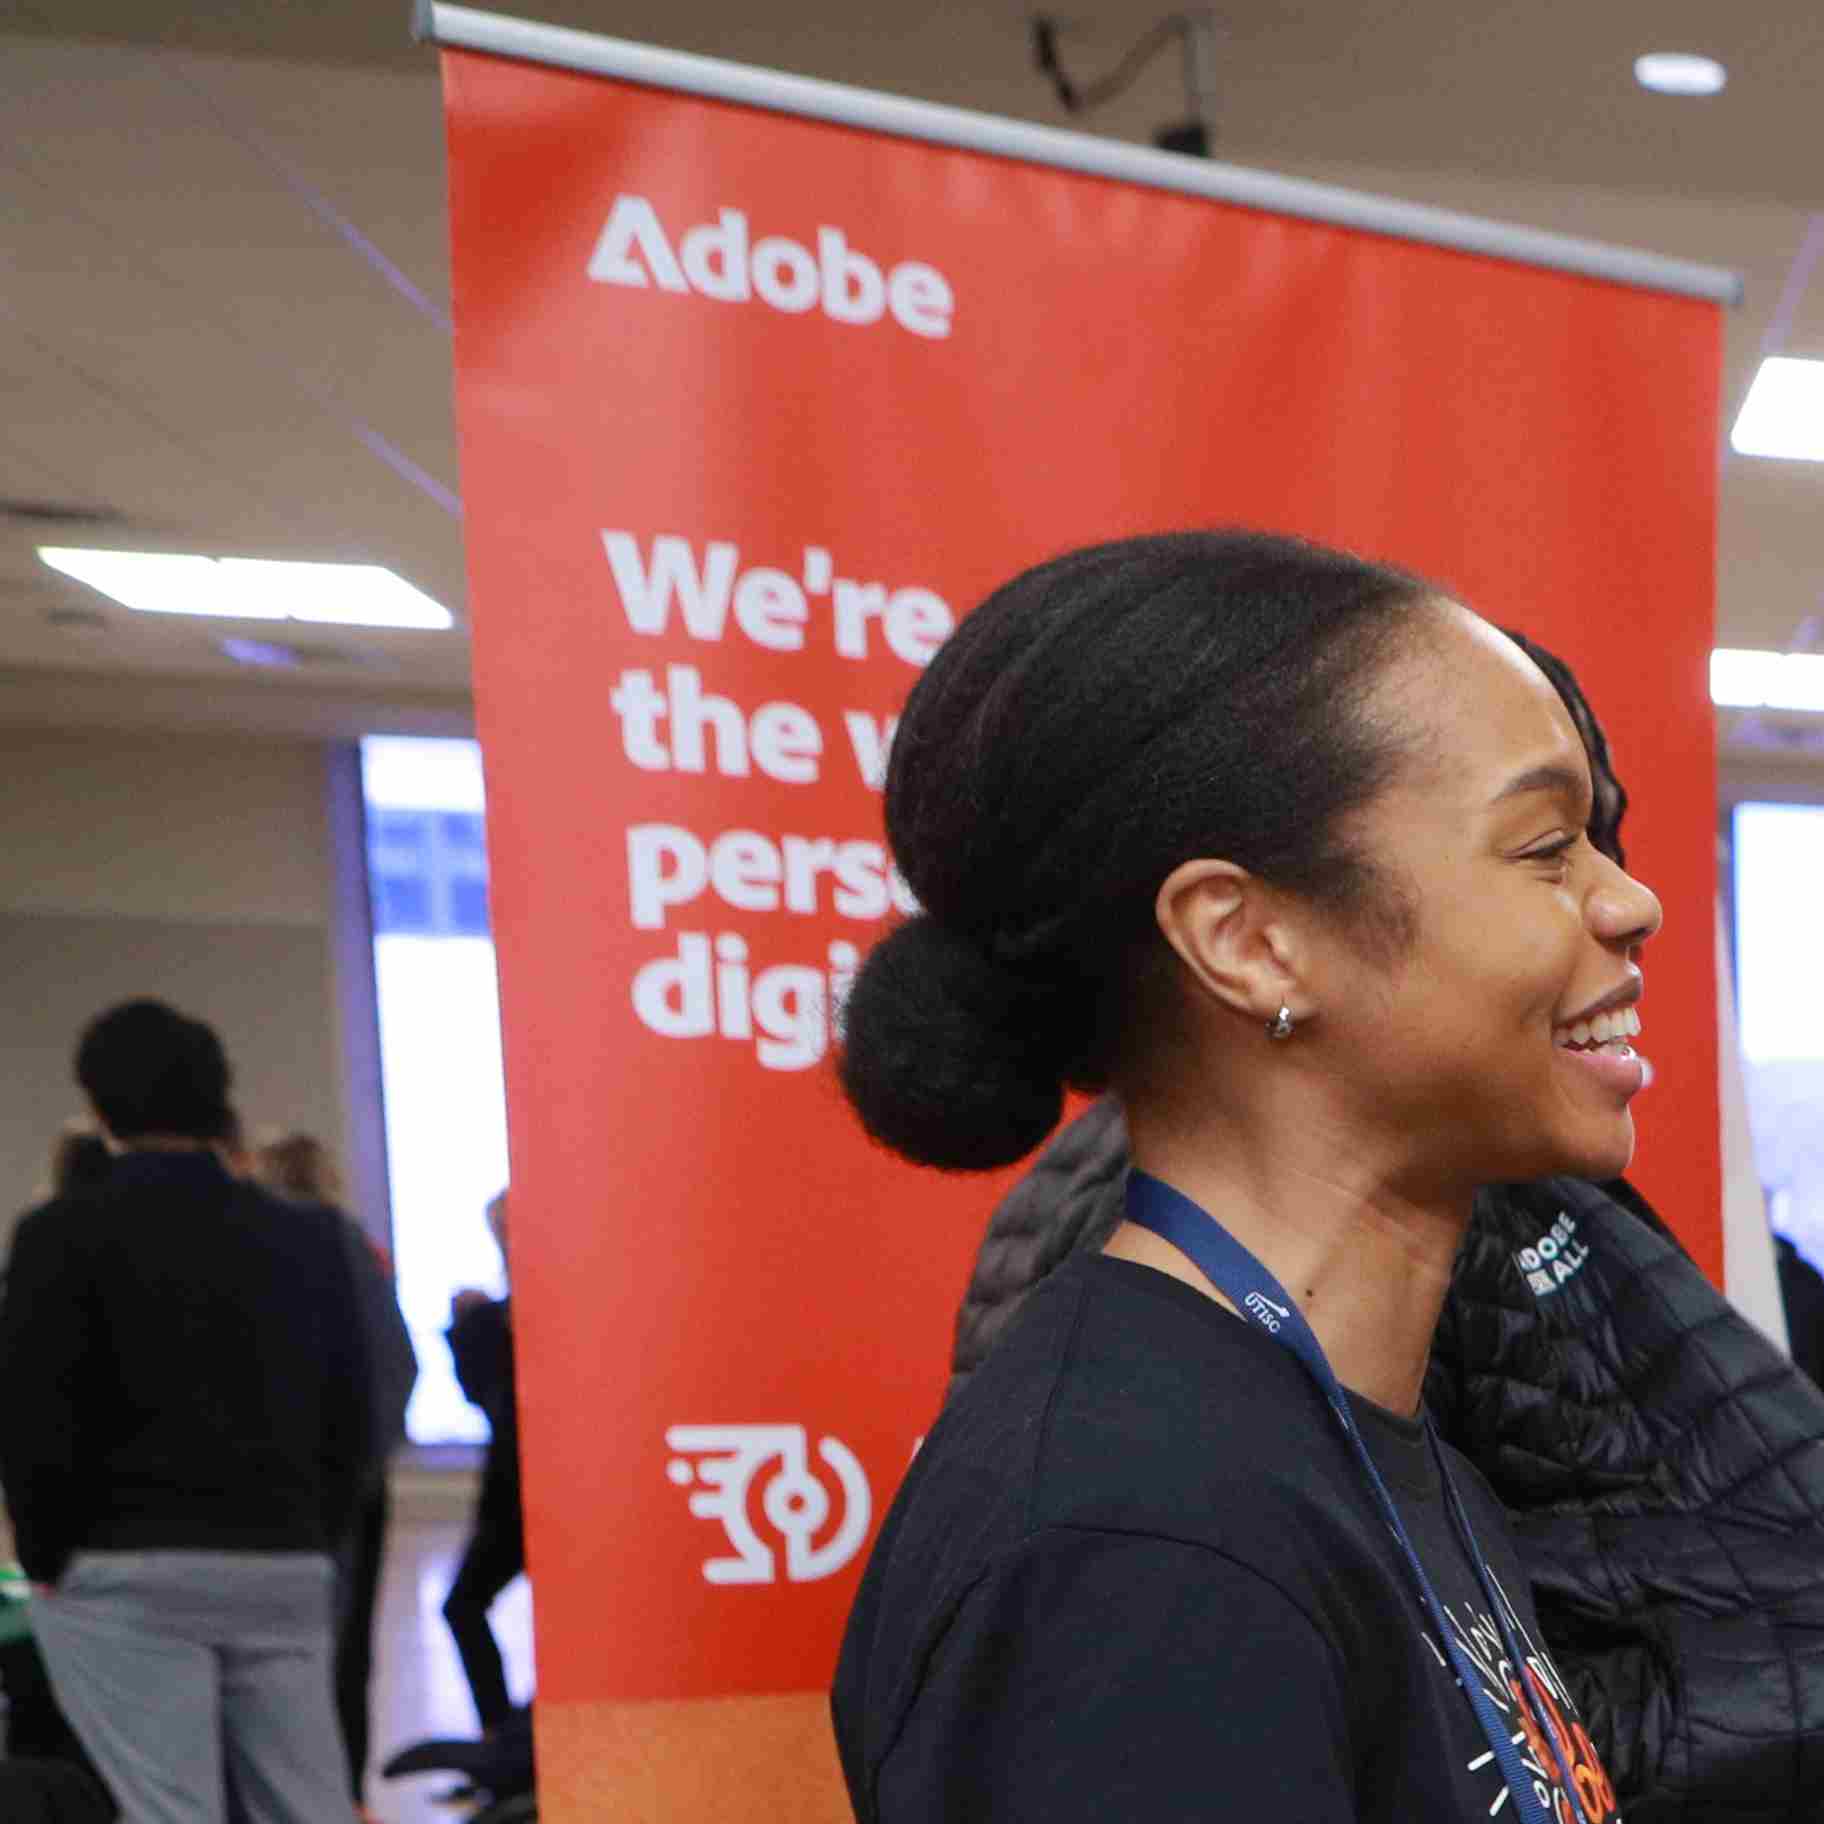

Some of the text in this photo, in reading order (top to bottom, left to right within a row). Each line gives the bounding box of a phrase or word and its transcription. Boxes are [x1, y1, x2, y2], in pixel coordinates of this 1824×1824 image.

[587, 194, 954, 339] Adobe
[601, 528, 956, 669] We're
[611, 664, 824, 785] the
[1512, 1209, 1578, 1272] DOBE
